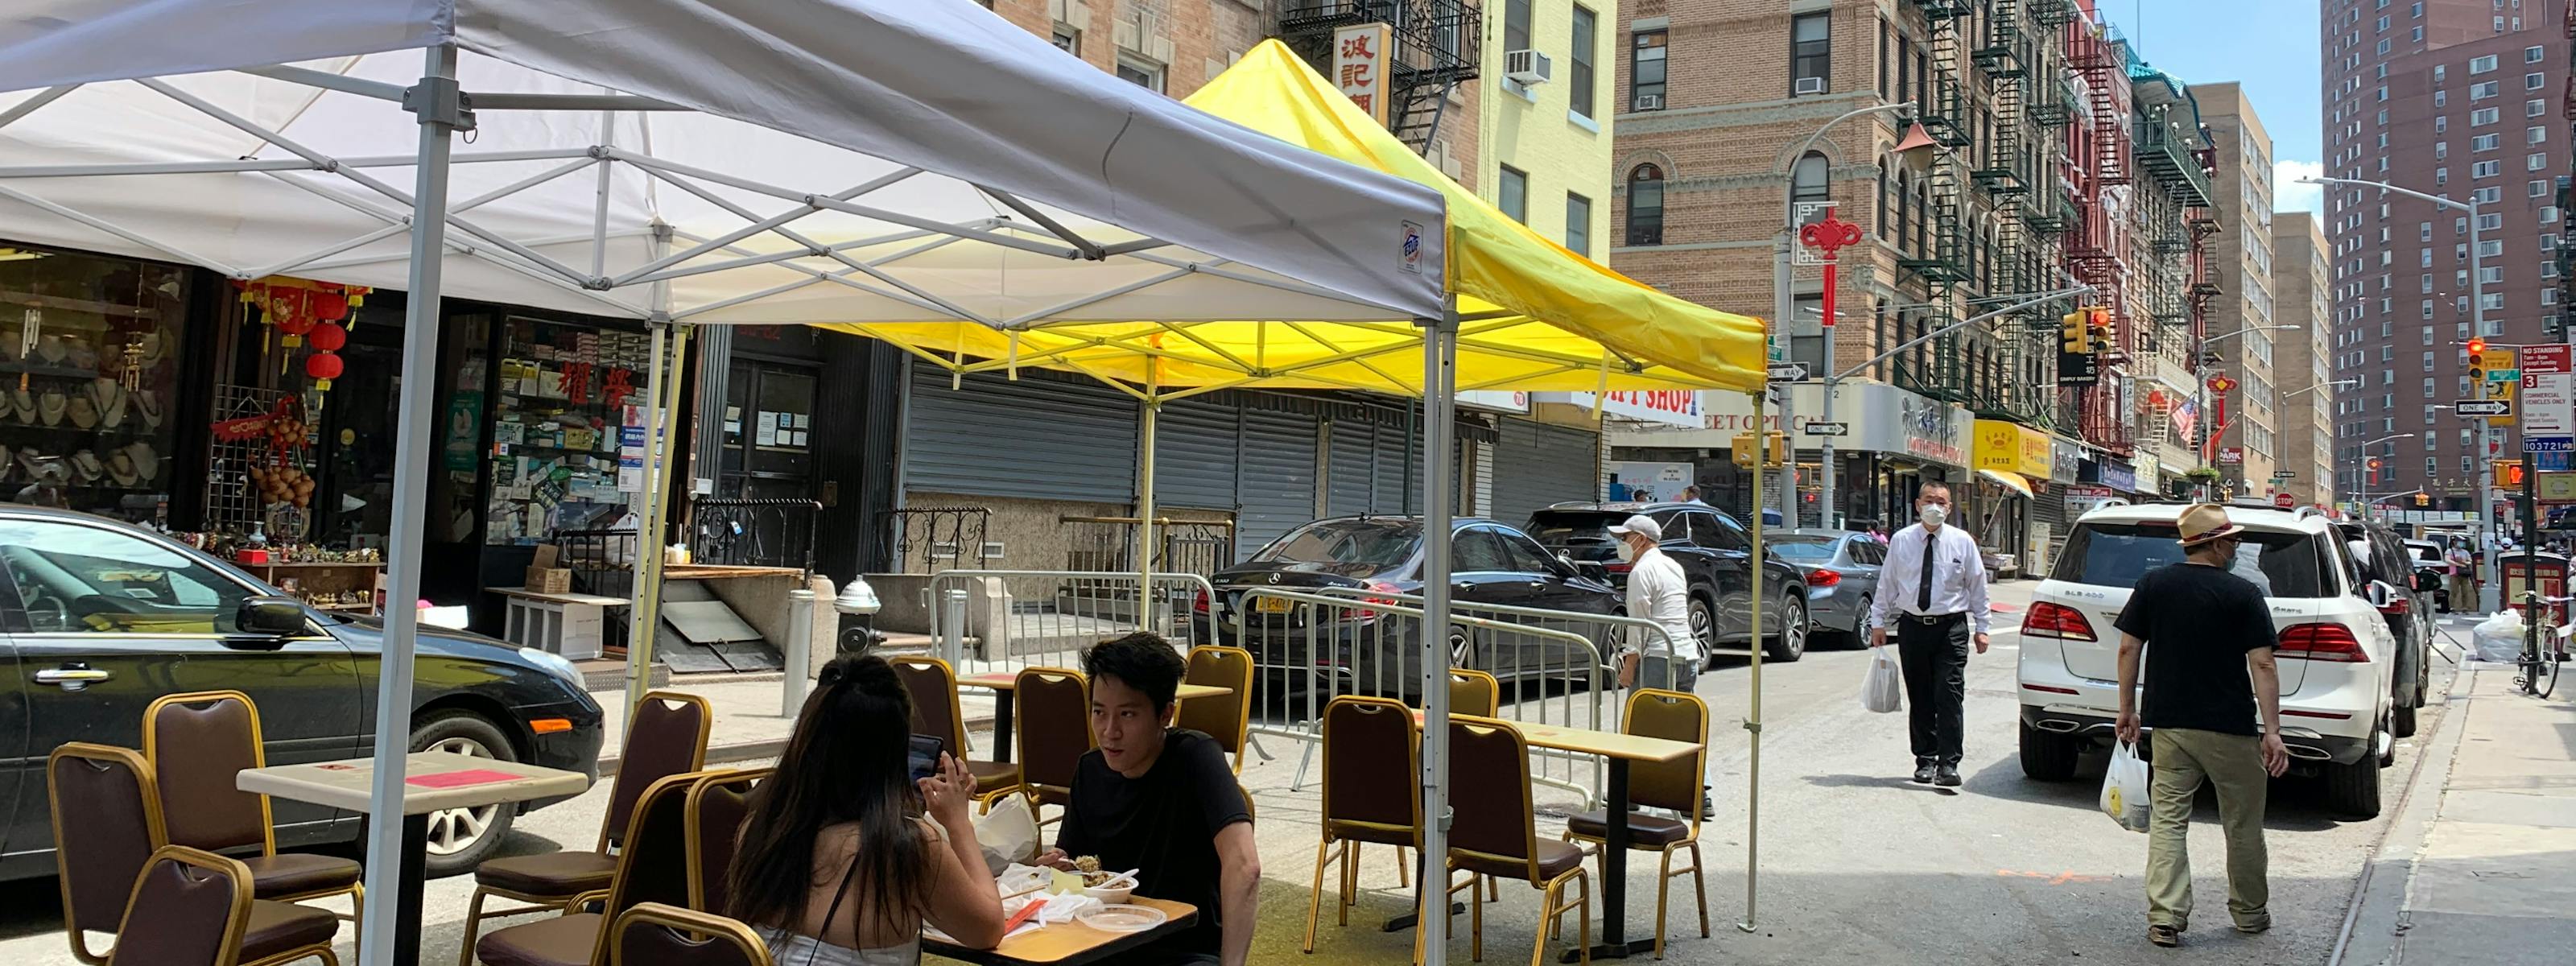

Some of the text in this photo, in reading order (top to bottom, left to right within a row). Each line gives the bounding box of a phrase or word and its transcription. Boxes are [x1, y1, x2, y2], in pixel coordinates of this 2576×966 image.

[1783, 369, 1800, 377] WAY
[2526, 376, 2534, 387] 3
[2525, 442, 2562, 450] 103721
